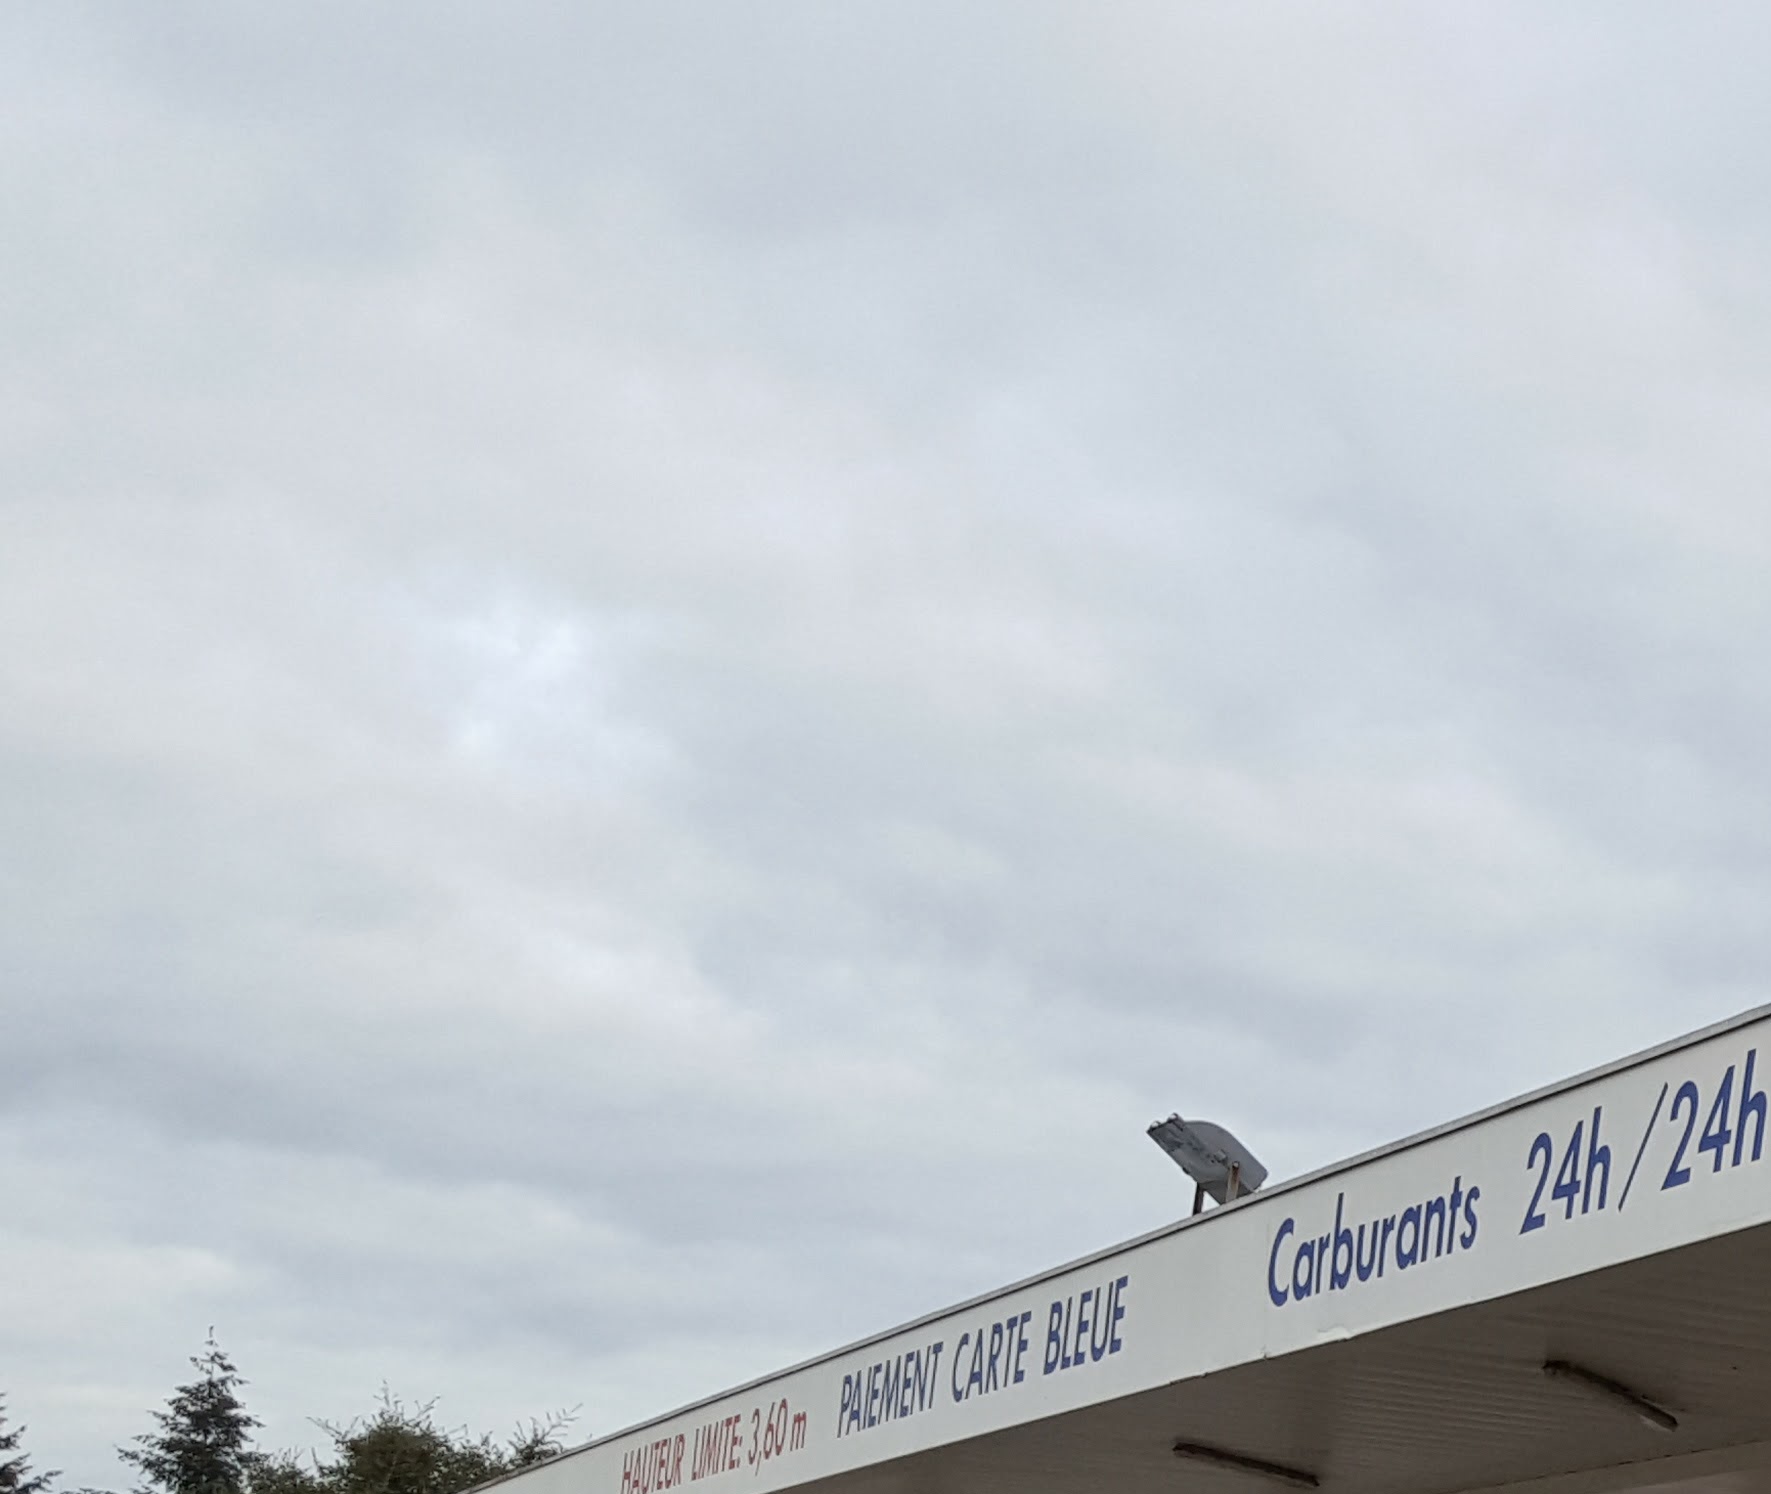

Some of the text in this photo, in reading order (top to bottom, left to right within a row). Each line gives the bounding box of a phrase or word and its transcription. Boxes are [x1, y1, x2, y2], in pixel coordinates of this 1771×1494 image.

[1267, 1176, 1481, 1308] Carburants
[837, 1275, 1129, 1438] PAIEMENT CARTE BLEUE
[748, 1398, 788, 1476] 3,60
[790, 1411, 807, 1452] m
